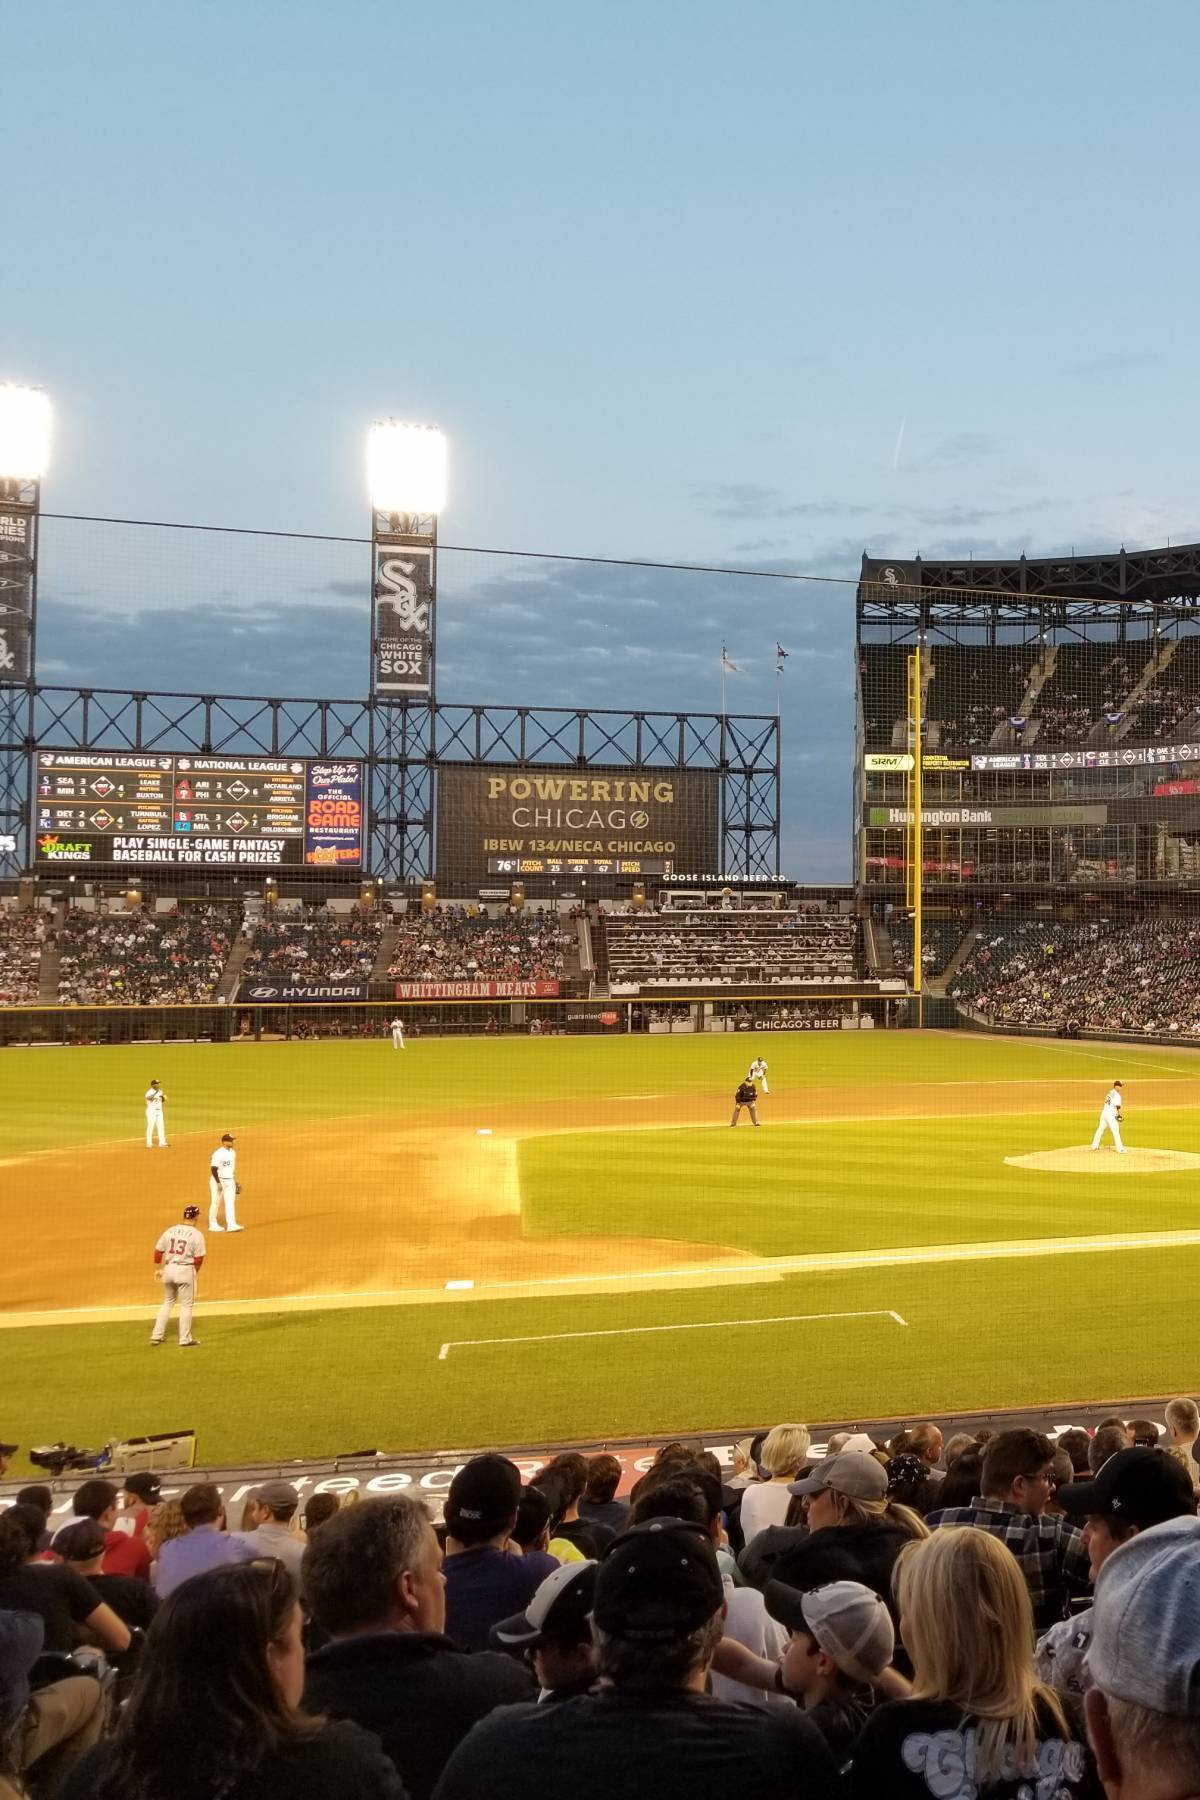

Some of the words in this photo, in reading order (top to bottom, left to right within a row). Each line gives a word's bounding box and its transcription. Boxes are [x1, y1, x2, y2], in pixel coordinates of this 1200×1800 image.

[0, 517, 26, 526] RLD
[380, 651, 422, 660] WHITE
[380, 660, 422, 675] SOX
[56, 756, 112, 766] AMERICAN
[115, 757, 156, 767] LEAGUE
[194, 760, 246, 770] NATIONAL
[248, 762, 288, 771] LEAGUE
[871, 758, 897, 766] SRM
[332, 764, 346, 775] Up
[346, 764, 358, 773] To
[57, 777, 74, 785] SEA
[195, 781, 210, 789] ARI
[56, 787, 74, 795] MIN
[488, 778, 674, 803] POWERING
[309, 800, 360, 814] ROAD
[56, 810, 73, 818] DET
[512, 807, 649, 829] CHICAGO
[889, 808, 960, 826] Hunington
[961, 808, 992, 823] Bank
[58, 820, 71, 828] KC
[308, 813, 360, 827] GAME
[41, 841, 92, 854] DRAFT
[113, 837, 145, 849] PLAY
[147, 837, 230, 851] SINGLE-GAME
[233, 839, 285, 851] FANTASY
[484, 838, 524, 851] IBEW
[529, 839, 603, 853] 134/NECA
[608, 841, 676, 853] CHICAGO
[47, 851, 91, 860] KINGS
[113, 850, 175, 862] BASEBALL
[178, 851, 202, 862] FOR
[205, 851, 236, 863] CASH
[239, 852, 281, 863] PRIZES
[702, 874, 739, 882] ISLAND
[283, 987, 361, 997] HYUNDAI
[400, 983, 490, 998] WHITTINGHAM
[496, 982, 537, 996] MEATS
[755, 1020, 812, 1030] CHICAGO'S
[814, 1019, 839, 1029] BEER
[168, 1238, 187, 1256] 13
